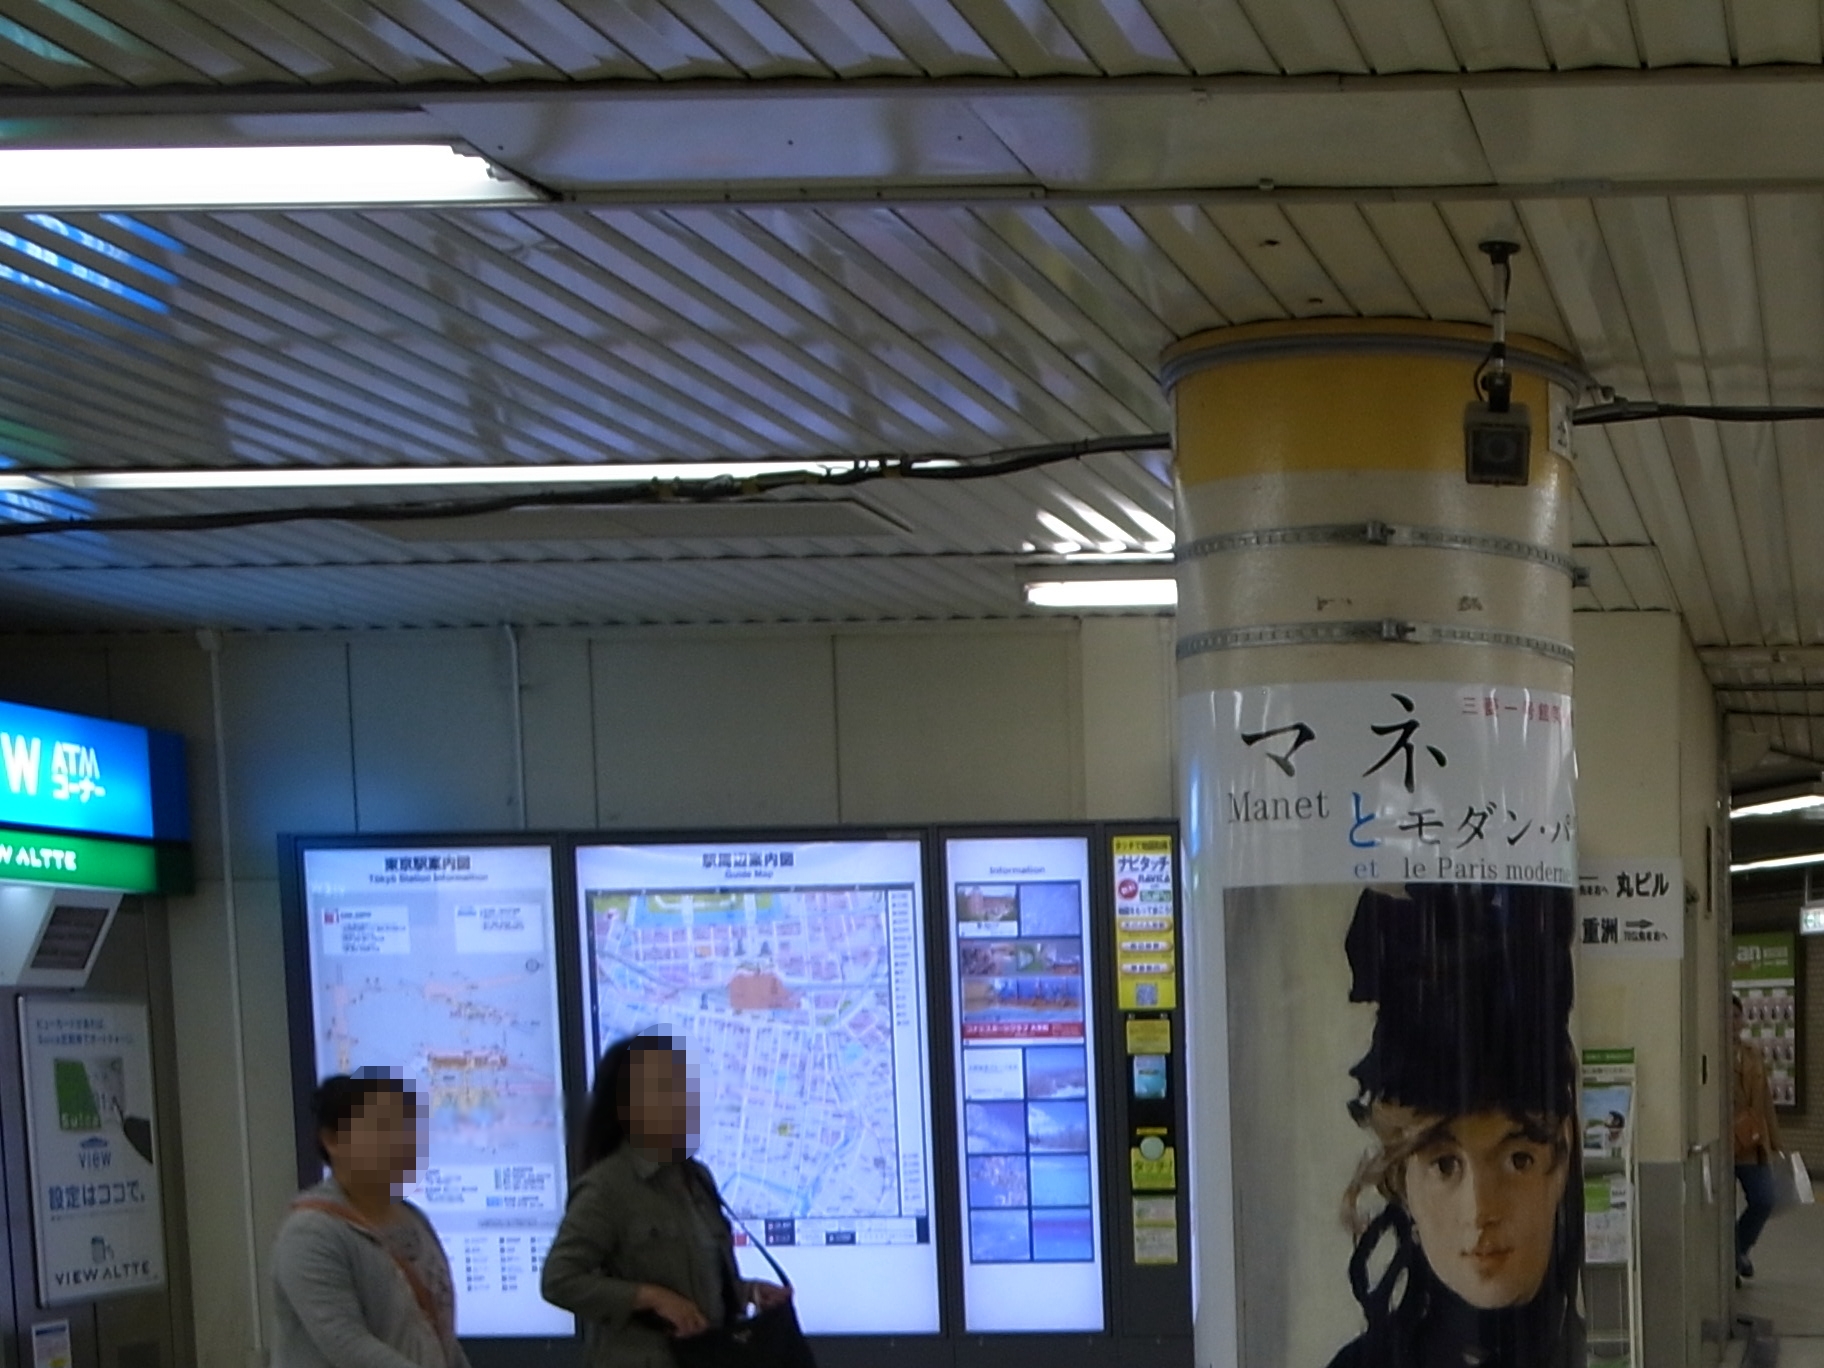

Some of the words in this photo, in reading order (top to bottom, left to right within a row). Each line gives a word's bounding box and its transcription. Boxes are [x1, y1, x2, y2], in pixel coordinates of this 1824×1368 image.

[51, 740, 101, 780] ATM
[1240, 692, 1448, 794] マネ
[1228, 791, 1330, 825] Manet
[1352, 860, 1380, 880] et
[1402, 857, 1428, 880] le
[1437, 857, 1499, 880] Paris
[1616, 871, 1670, 898] 丸ビル
